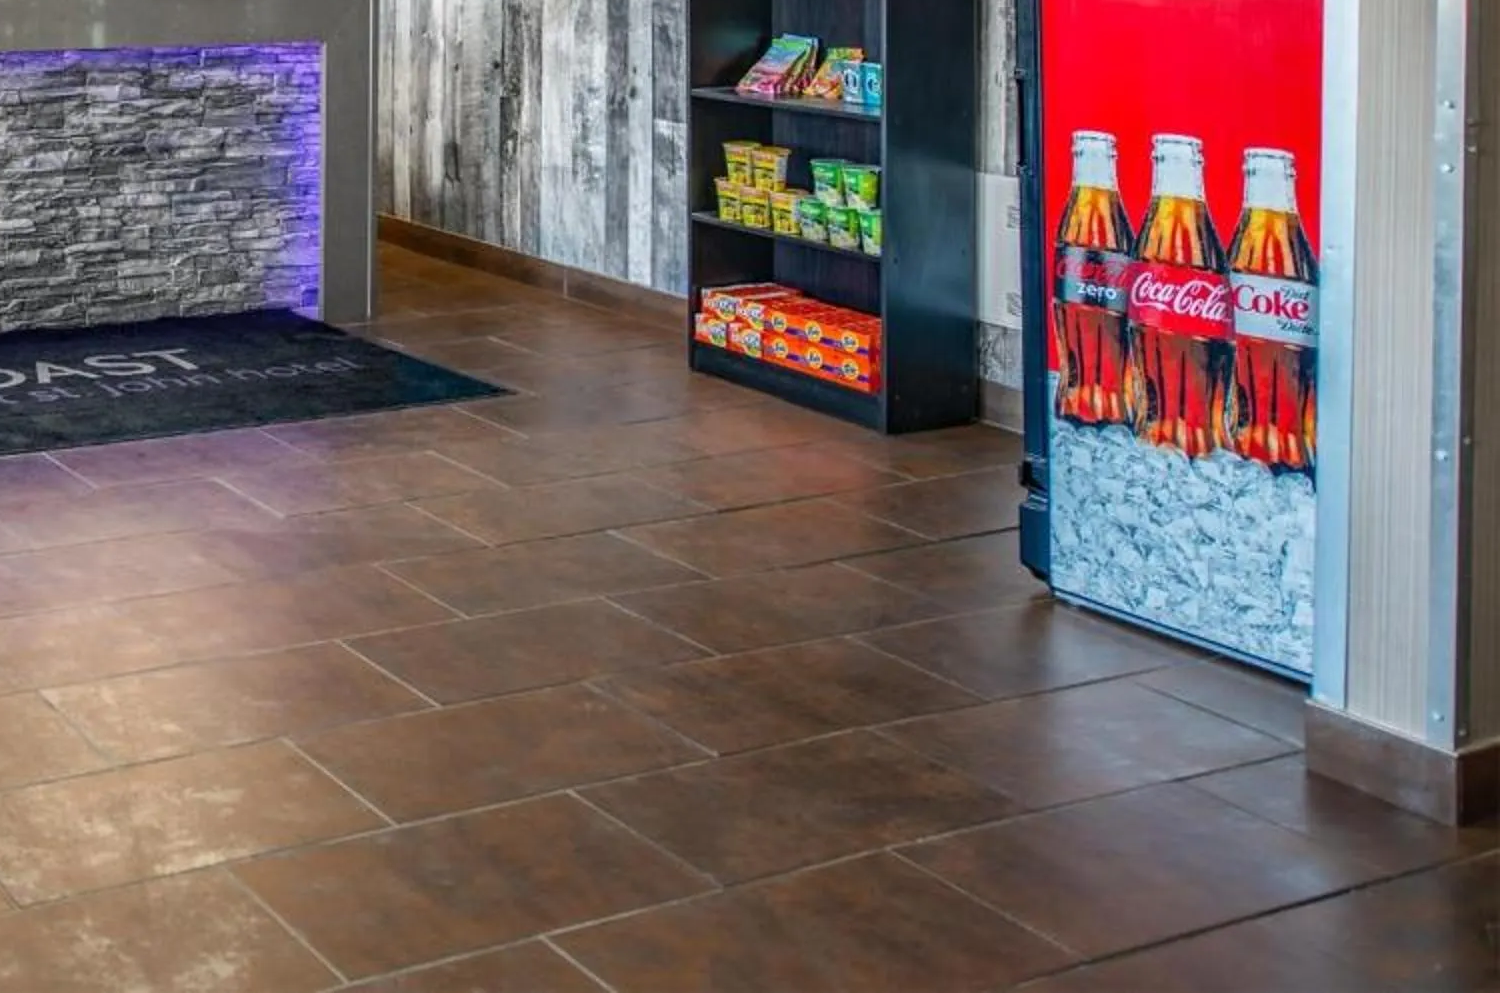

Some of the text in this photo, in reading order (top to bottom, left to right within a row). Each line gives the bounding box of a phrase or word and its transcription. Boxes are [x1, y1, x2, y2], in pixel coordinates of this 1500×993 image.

[1075, 281, 1118, 301] zero
[1130, 271, 1229, 321] Coca-Cola
[1232, 283, 1310, 322] Coke
